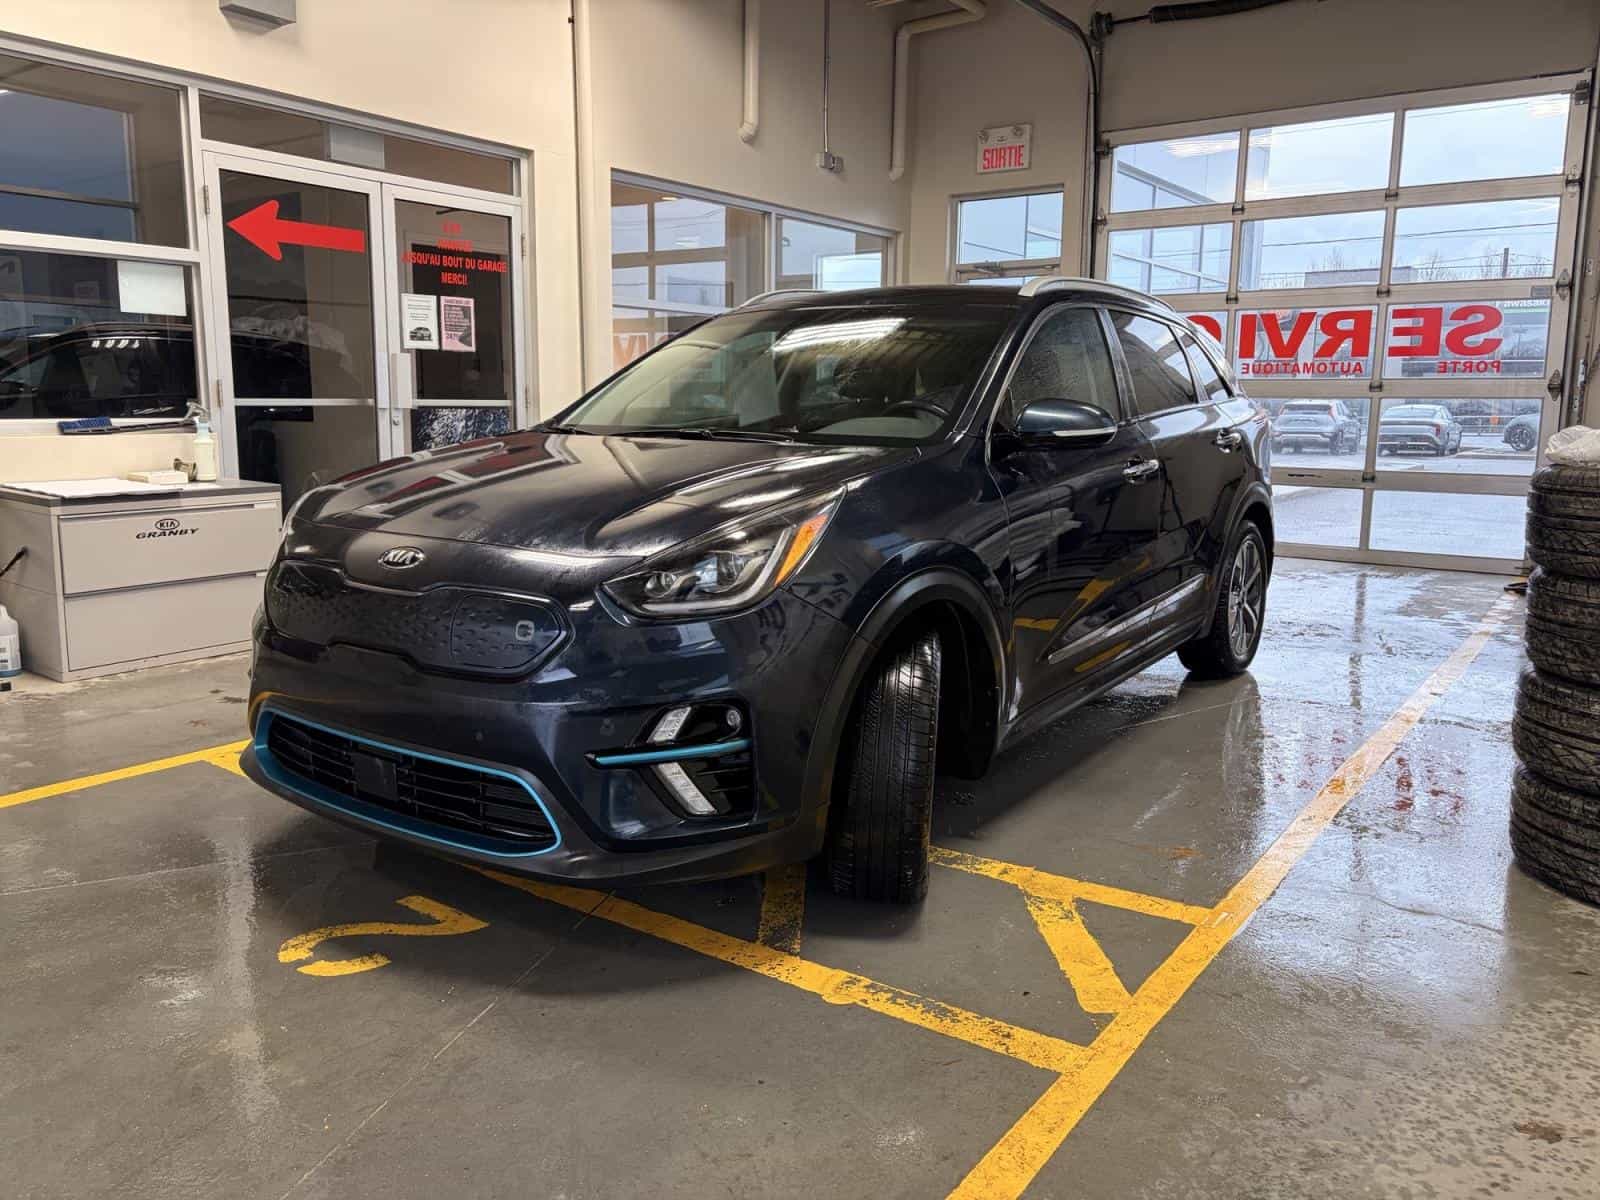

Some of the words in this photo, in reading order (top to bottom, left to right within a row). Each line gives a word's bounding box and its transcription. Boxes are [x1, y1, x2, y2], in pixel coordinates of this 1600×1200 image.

[983, 144, 1025, 170] SORTIE
[442, 255, 464, 269] BOUT
[465, 258, 476, 271] DU
[477, 259, 508, 273] GARAGE
[158, 520, 178, 529] KIA
[136, 528, 199, 540] GRANBY
[382, 547, 419, 567] KIA
